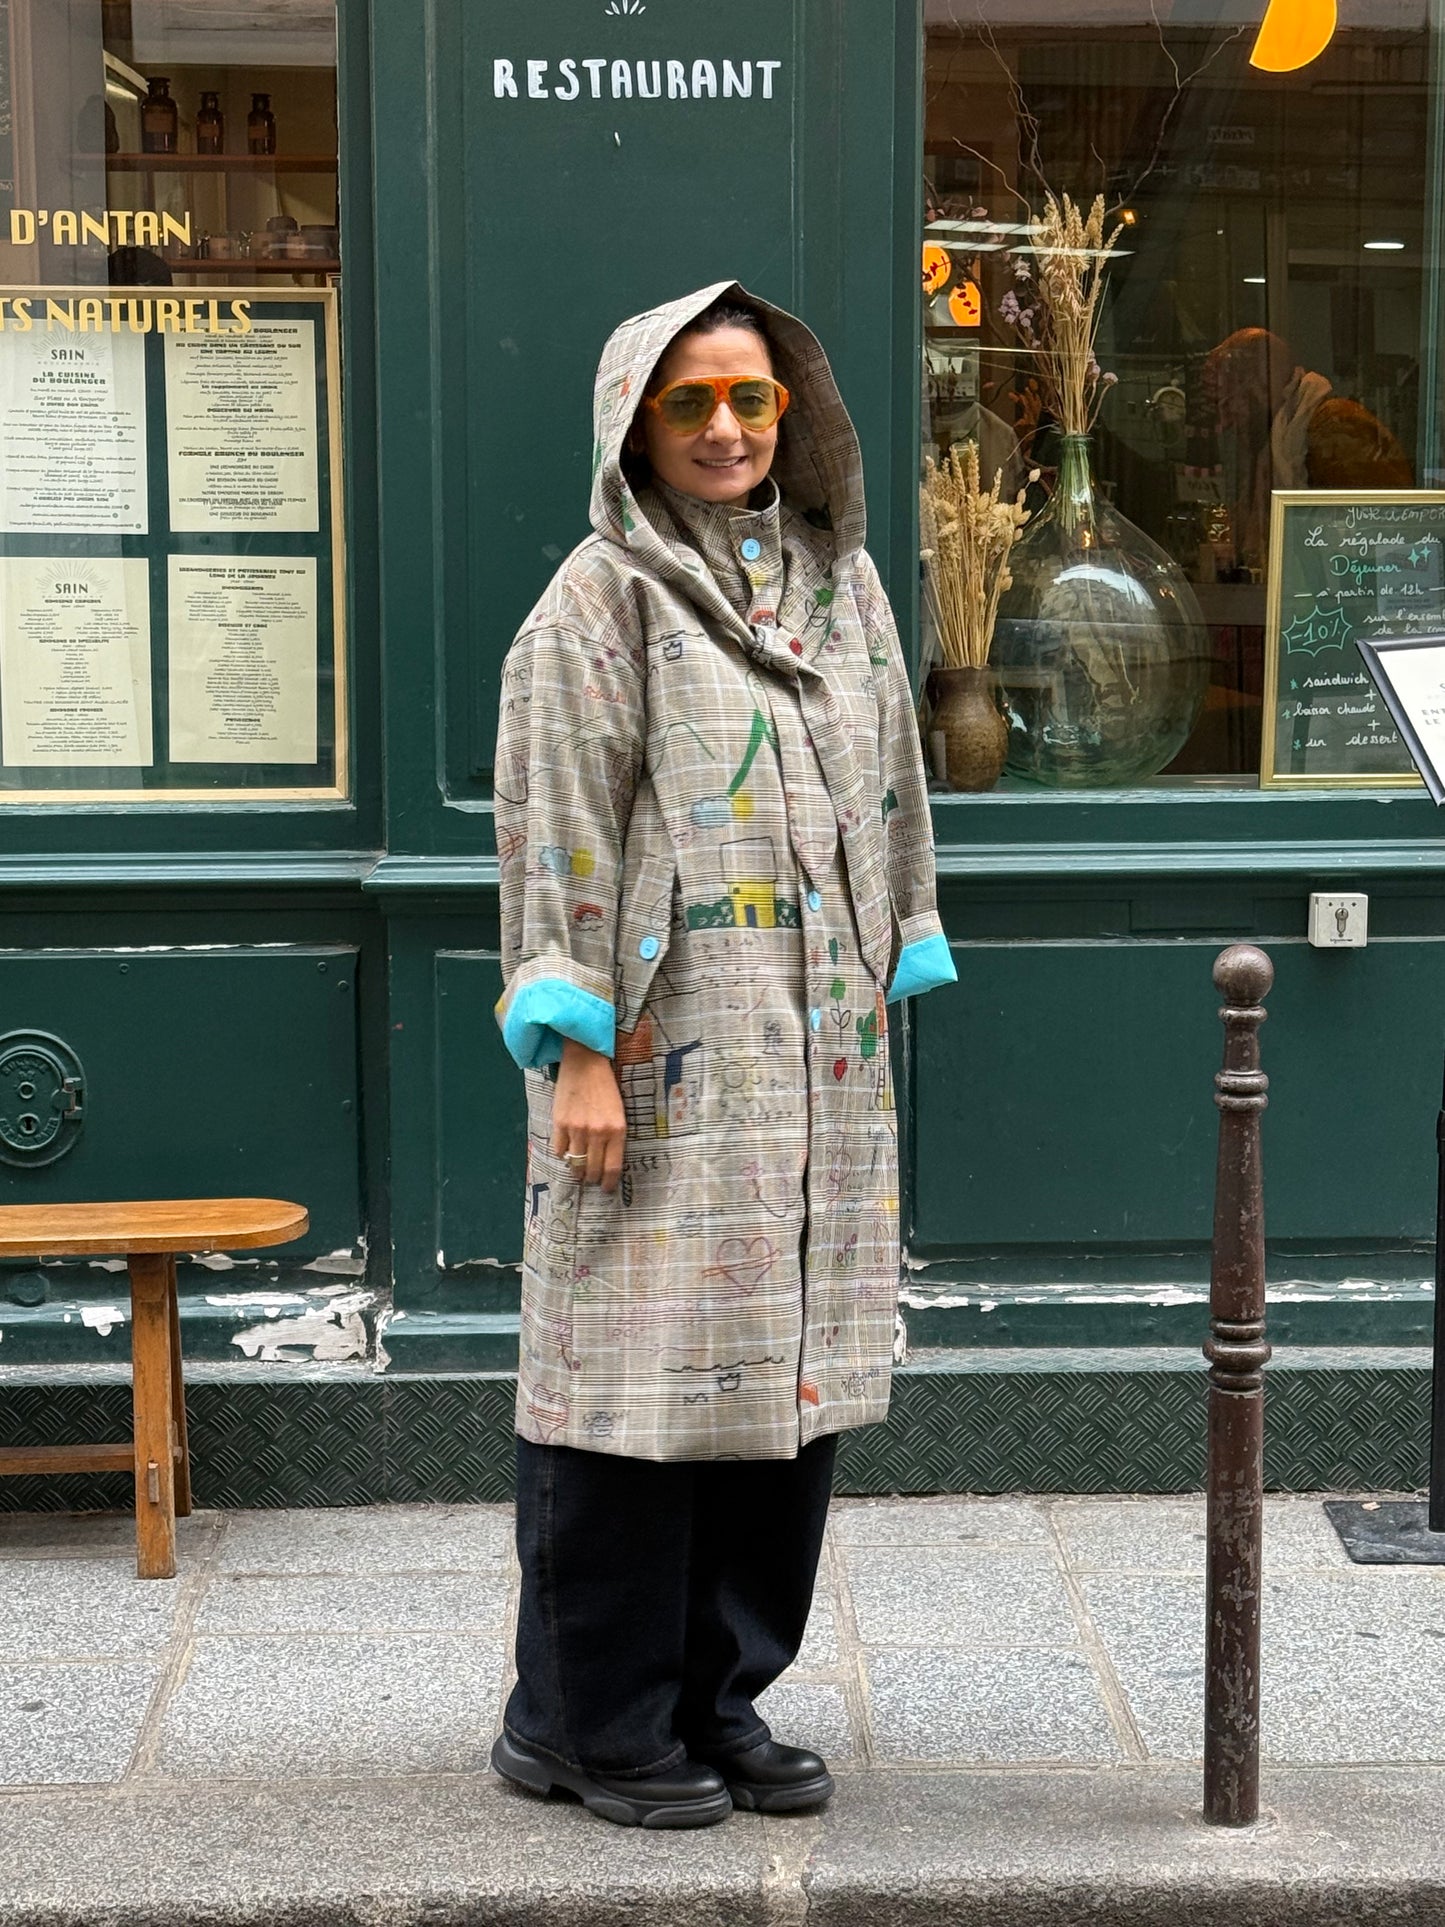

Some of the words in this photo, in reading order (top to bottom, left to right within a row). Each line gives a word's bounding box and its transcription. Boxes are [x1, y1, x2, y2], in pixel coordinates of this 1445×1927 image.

[492, 58, 782, 100] RESTAURANT
[10, 209, 191, 246] D'ANTAN
[47, 298, 251, 333] NATURELS
[51, 349, 85, 360] SAIN
[1304, 526, 1329, 547] La
[1339, 531, 1405, 556] régalade
[1414, 532, 1440, 545] du
[1329, 554, 1402, 585] Déjeuner
[55, 583, 89, 594] SAIN
[1380, 584, 1394, 595] de
[1400, 583, 1425, 595] 12h
[1362, 615, 1390, 624] sur
[1372, 623, 1395, 636] de
[1403, 622, 1422, 634] la
[1337, 702, 1376, 715] chaude
[1305, 737, 1327, 747] un
[1345, 731, 1398, 746] dessert
